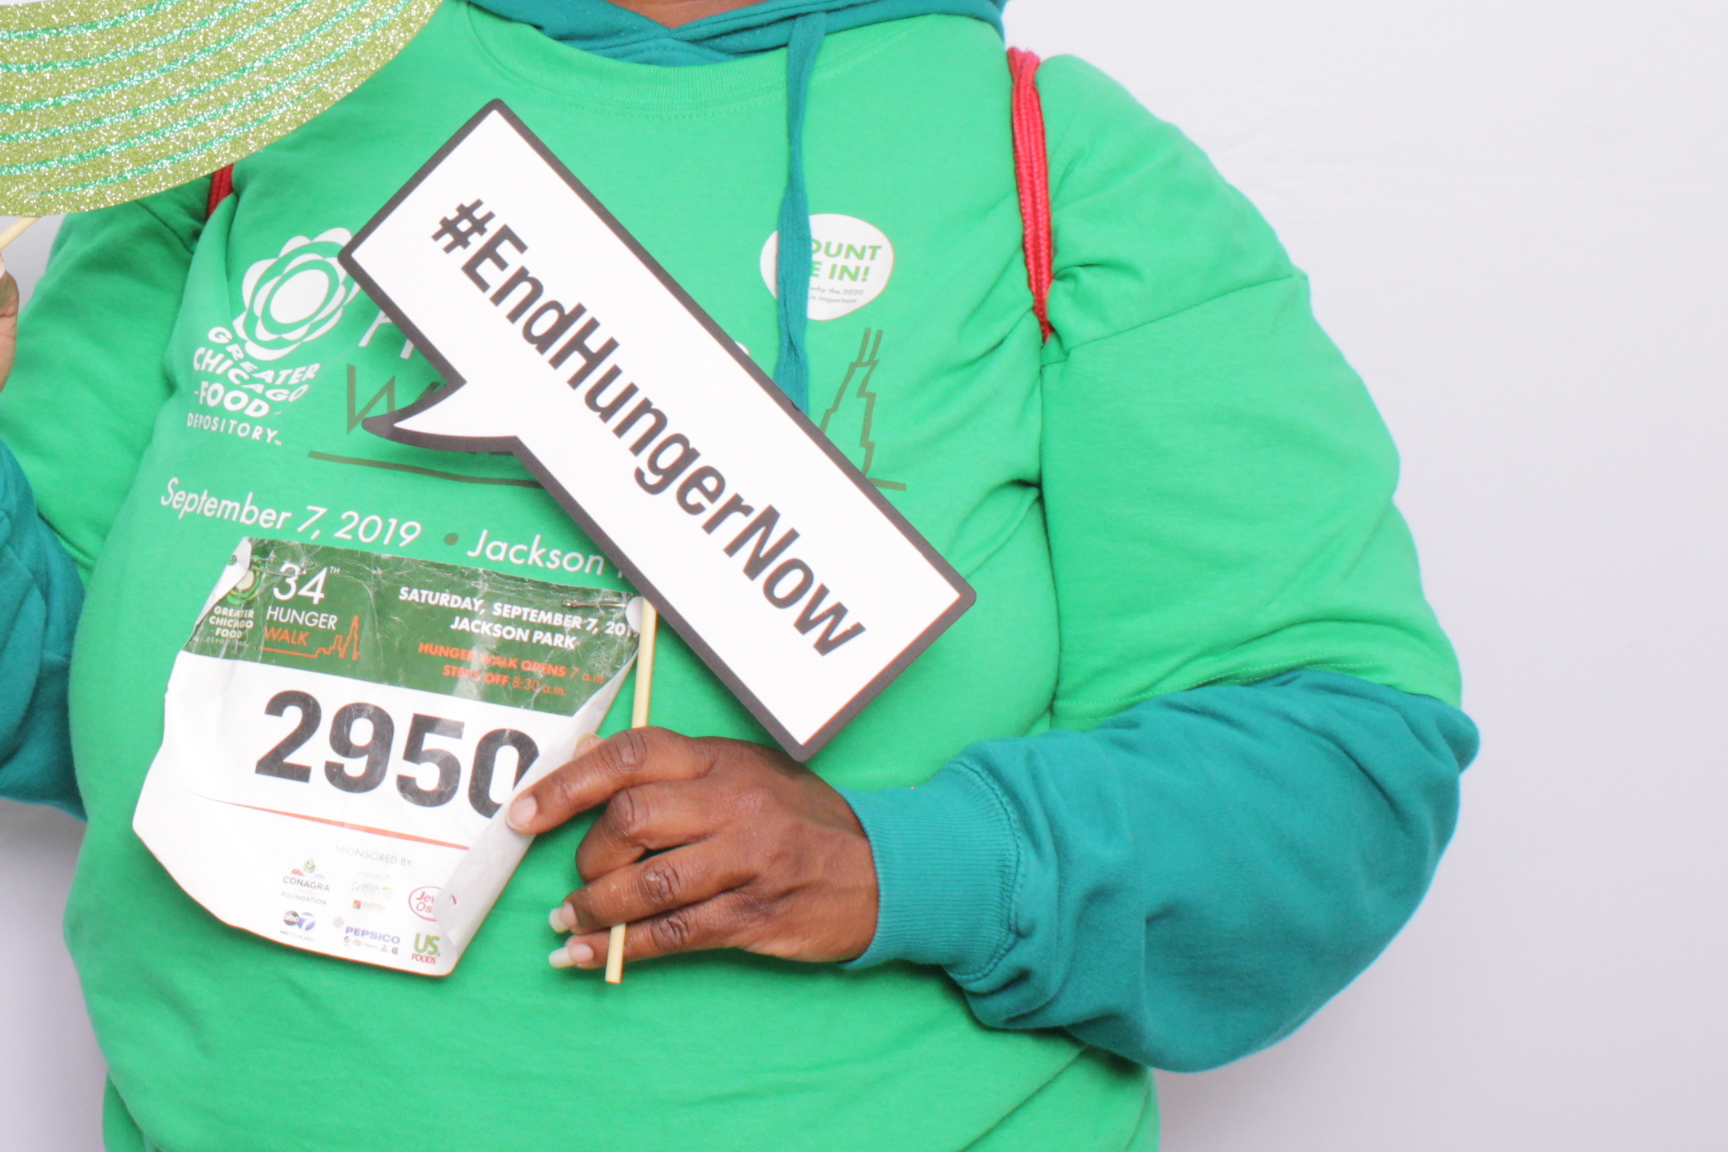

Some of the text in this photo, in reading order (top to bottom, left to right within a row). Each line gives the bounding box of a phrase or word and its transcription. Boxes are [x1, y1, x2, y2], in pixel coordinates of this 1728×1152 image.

[812, 238, 882, 260] OUNT
[829, 264, 870, 282] IN!
[818, 295, 858, 305] important
[828, 287, 841, 295] the
[207, 326, 321, 385] GREATER
[193, 346, 310, 402] CHICAGO
[431, 198, 866, 656] #EndHungerNow
[160, 477, 605, 576] September 7, 2019 Jackson
[213, 606, 254, 618] GREATER
[266, 606, 338, 630] HUNGER
[398, 586, 639, 639] SATURDAY, SEPTEMBER 7, 201
[209, 616, 254, 629] CHICAGO
[215, 628, 243, 639] FOOD
[264, 626, 311, 646] WALK
[450, 616, 578, 650] JACKSON PARK
[418, 642, 607, 684] HUNGER WALK OPENS 7 a.m.
[442, 664, 567, 696] STEPS OFF 8:30 a.m.
[254, 690, 540, 820] 2950
[334, 845, 398, 864] SPONSORED
[282, 876, 330, 892] CONAGRA
[281, 891, 327, 905] FOUNDATION
[345, 926, 401, 944] PEPSICO
[411, 953, 437, 965] FOODS
